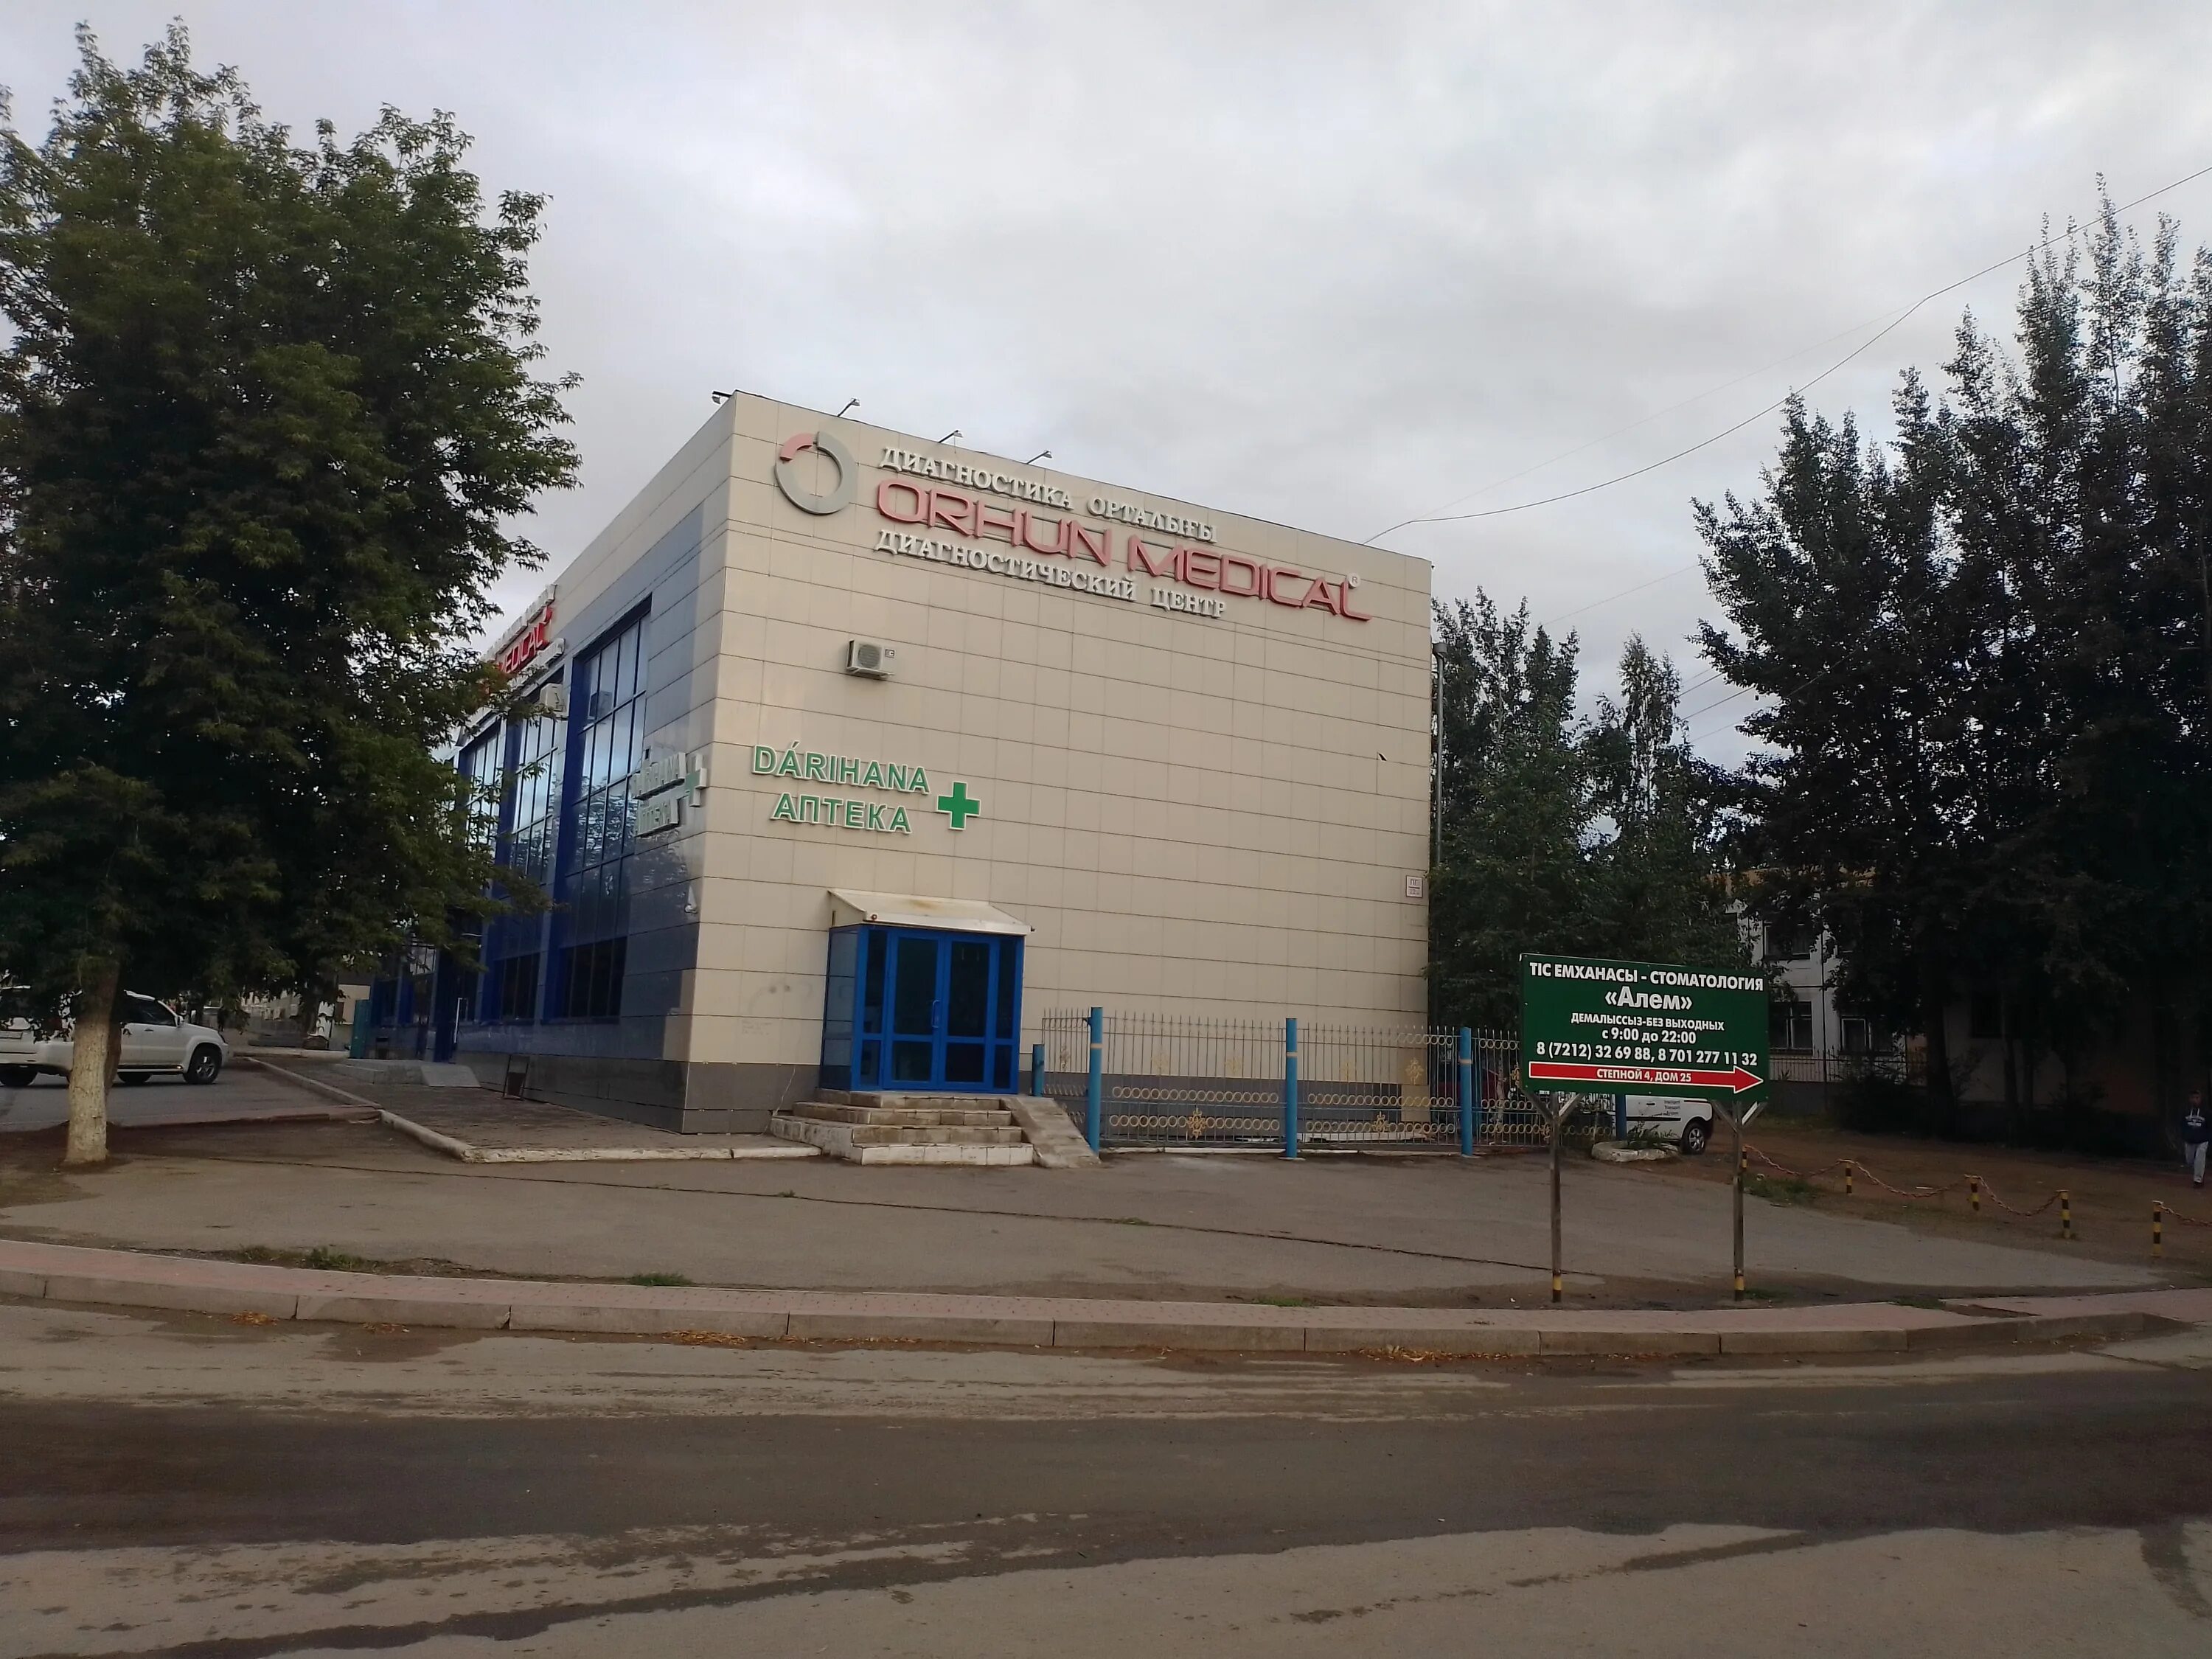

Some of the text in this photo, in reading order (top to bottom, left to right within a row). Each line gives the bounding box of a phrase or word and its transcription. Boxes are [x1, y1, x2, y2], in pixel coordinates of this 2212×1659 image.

[879, 448, 1218, 543] ДИАГНОСТИКА ОРТАЛЫҒЫ
[877, 481, 1113, 567] ORHUN
[1127, 534, 1372, 622] MEDICAL
[874, 529, 1228, 619] ДИАГНОСТИЧЕСКИЙ ЦЕНТР
[752, 740, 931, 796] DÁRIHANA
[770, 793, 913, 835] АПТЕКА
[1530, 962, 1551, 977] ТІС
[1554, 964, 1638, 983] ЕМХАНАСЫ
[1650, 971, 1764, 991] СТОМАТОЛОГИЯ
[1605, 986, 1693, 1010] «Алем»
[1571, 1012, 1725, 1031] ДЕМАЛЫССЫЗ-БЕЗ ВЫХОДНЫХ
[1601, 1027, 1697, 1044] с 9:00 до 22:00
[1537, 1042, 1757, 1066] 8 (7212) 32 69 88, 8 701 277 11 32
[1596, 1068, 1691, 1082] СТЕПНОЙ 4, ДОМ 25
